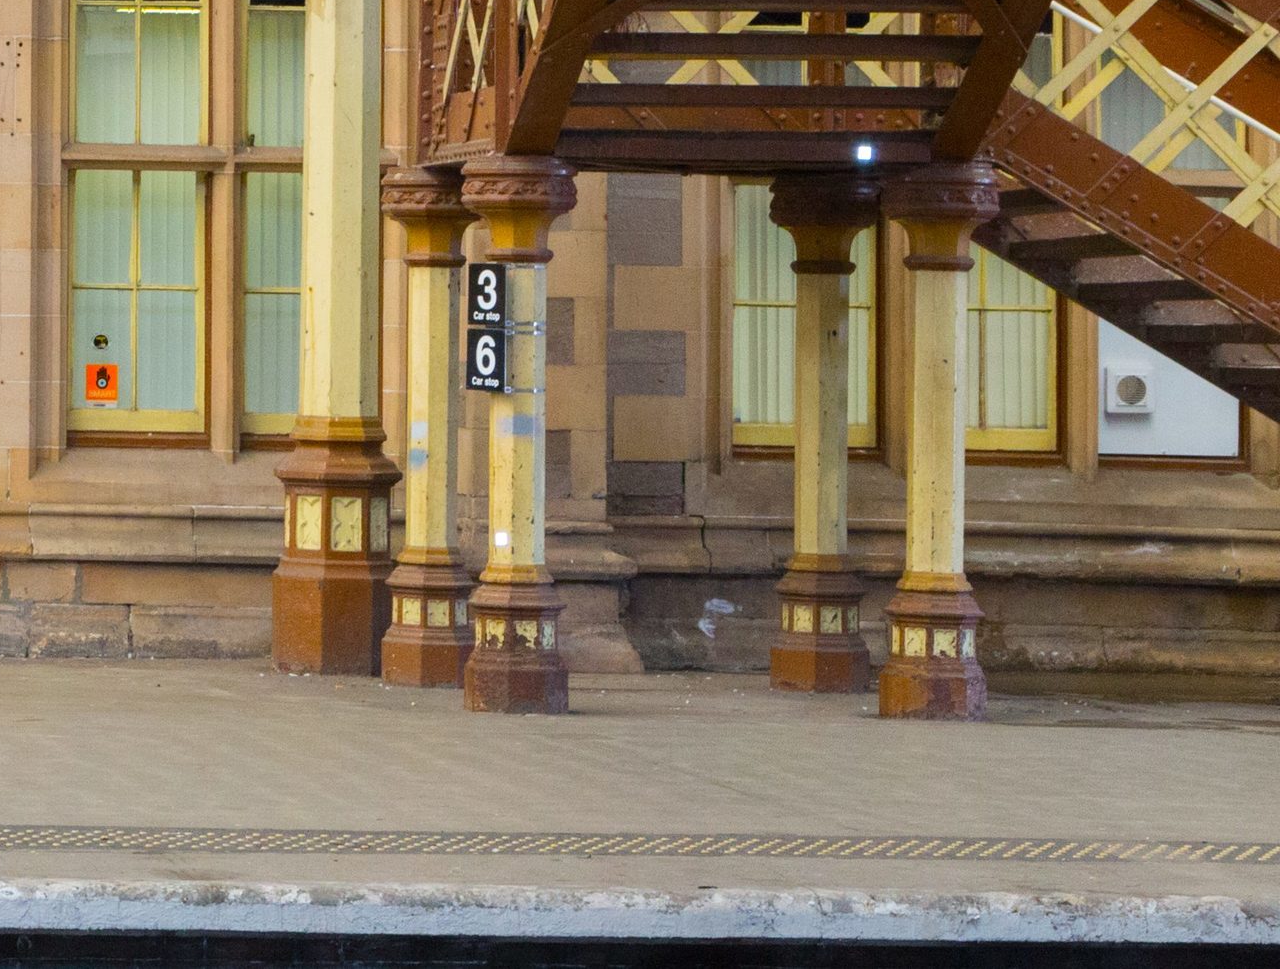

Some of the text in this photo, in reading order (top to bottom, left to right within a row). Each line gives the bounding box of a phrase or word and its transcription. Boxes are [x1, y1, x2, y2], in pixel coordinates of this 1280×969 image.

[477, 269, 497, 310] 3
[473, 312, 500, 321] Car stop
[476, 335, 496, 375] 6
[472, 377, 499, 387] Car stop
